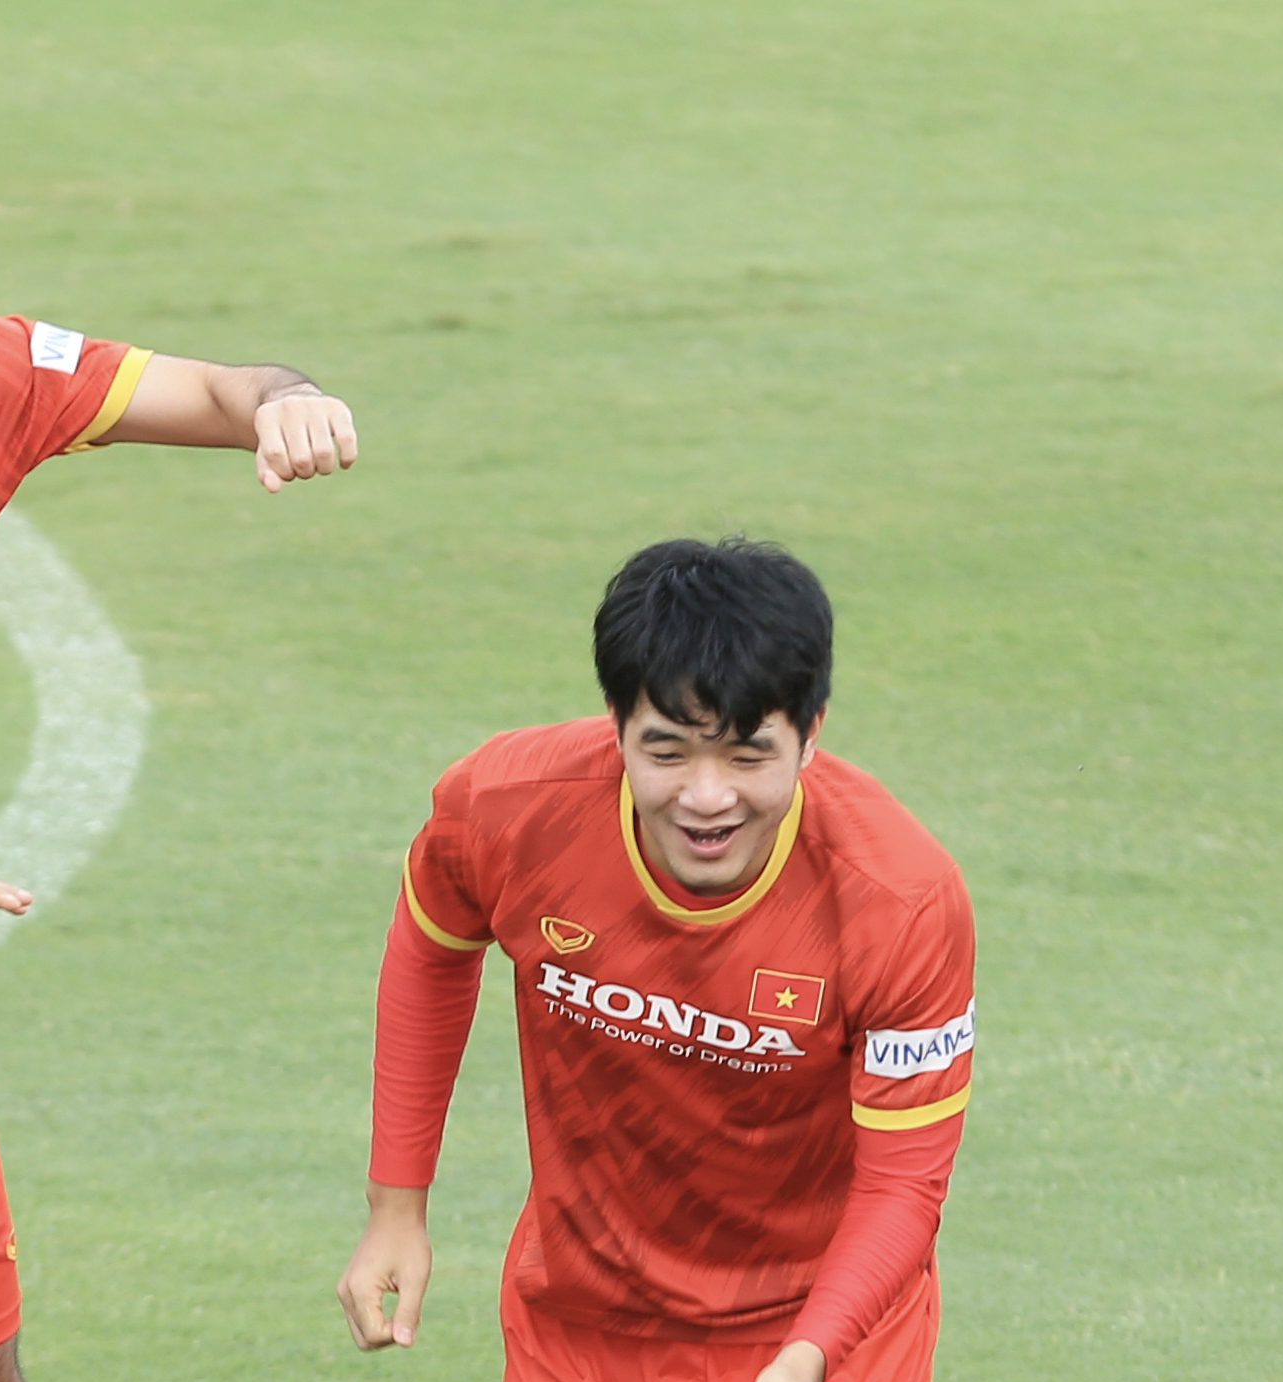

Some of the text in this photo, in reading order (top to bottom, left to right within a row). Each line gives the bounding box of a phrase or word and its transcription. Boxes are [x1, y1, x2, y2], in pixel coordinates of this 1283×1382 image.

[536, 962, 806, 1057] HONDA
[544, 997, 793, 1074] The Power of Dreams
